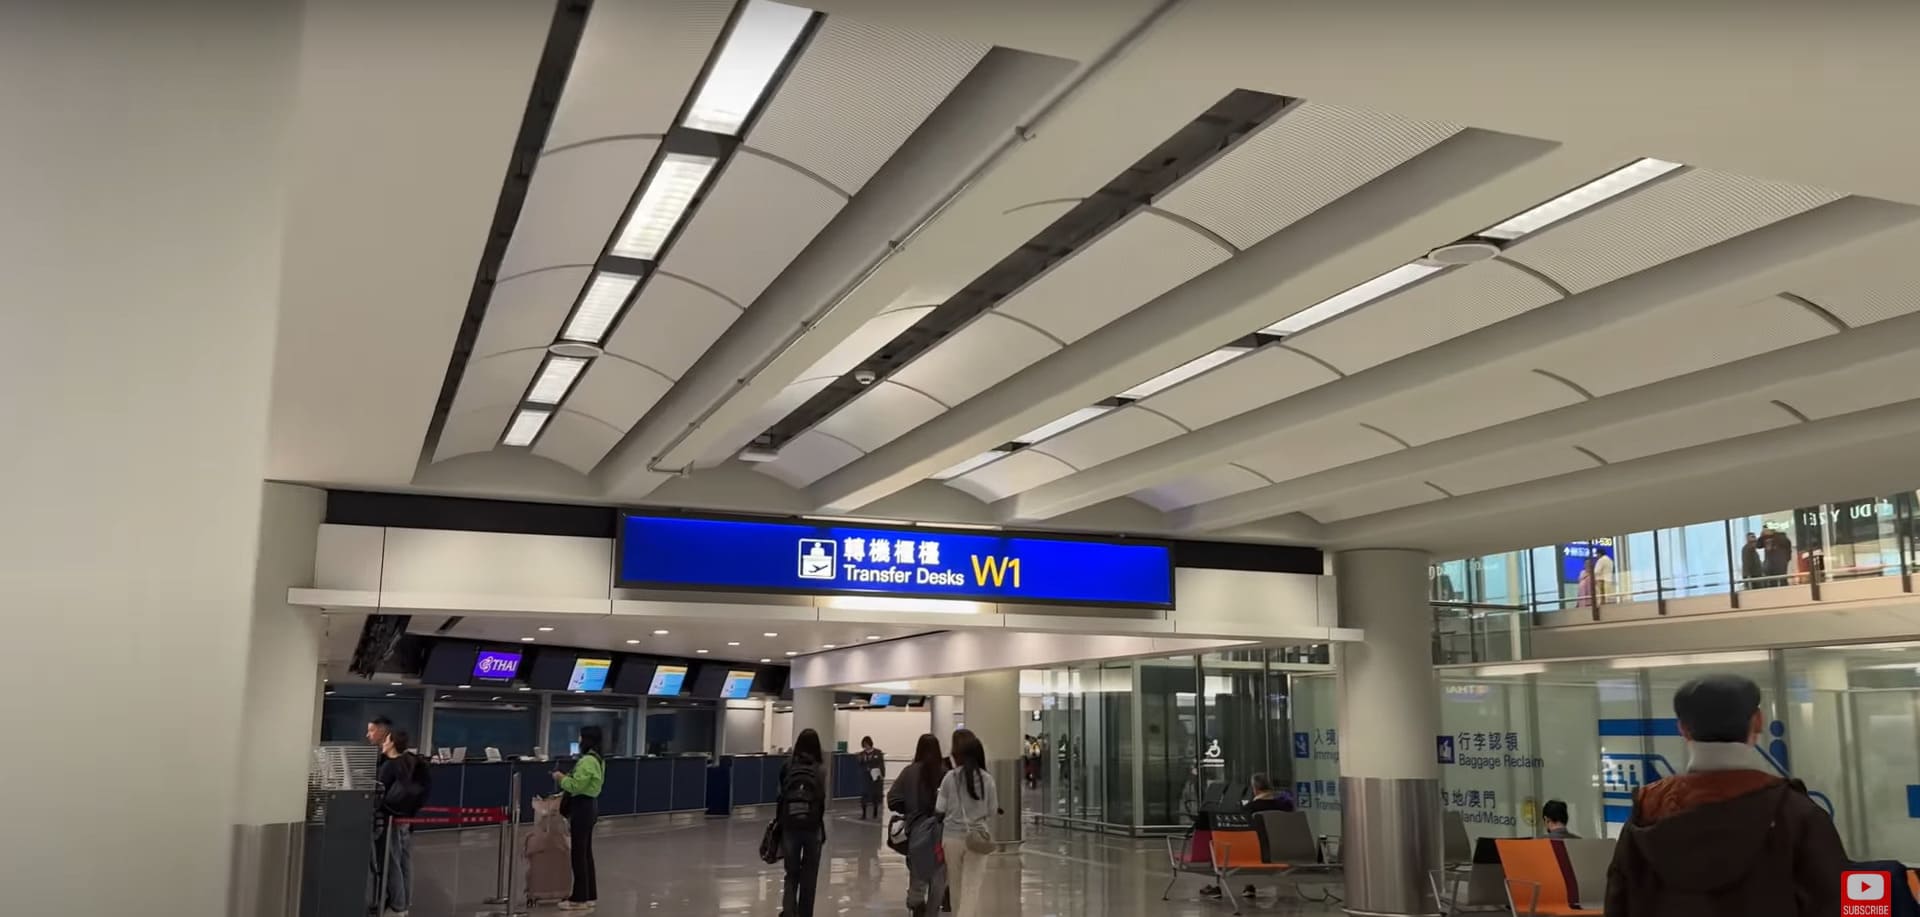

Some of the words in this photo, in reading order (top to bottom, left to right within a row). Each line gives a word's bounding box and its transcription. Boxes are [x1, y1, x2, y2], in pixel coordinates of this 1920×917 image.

[843, 537, 940, 565] 轉機櫃檯
[843, 564, 912, 584] Transfer
[916, 567, 965, 586] Desks
[971, 554, 1021, 588] W1
[492, 658, 518, 672] THAI
[1458, 731, 1519, 751] 行李認領
[1459, 753, 1501, 769] Baggage
[1504, 754, 1544, 769] Reclaim
